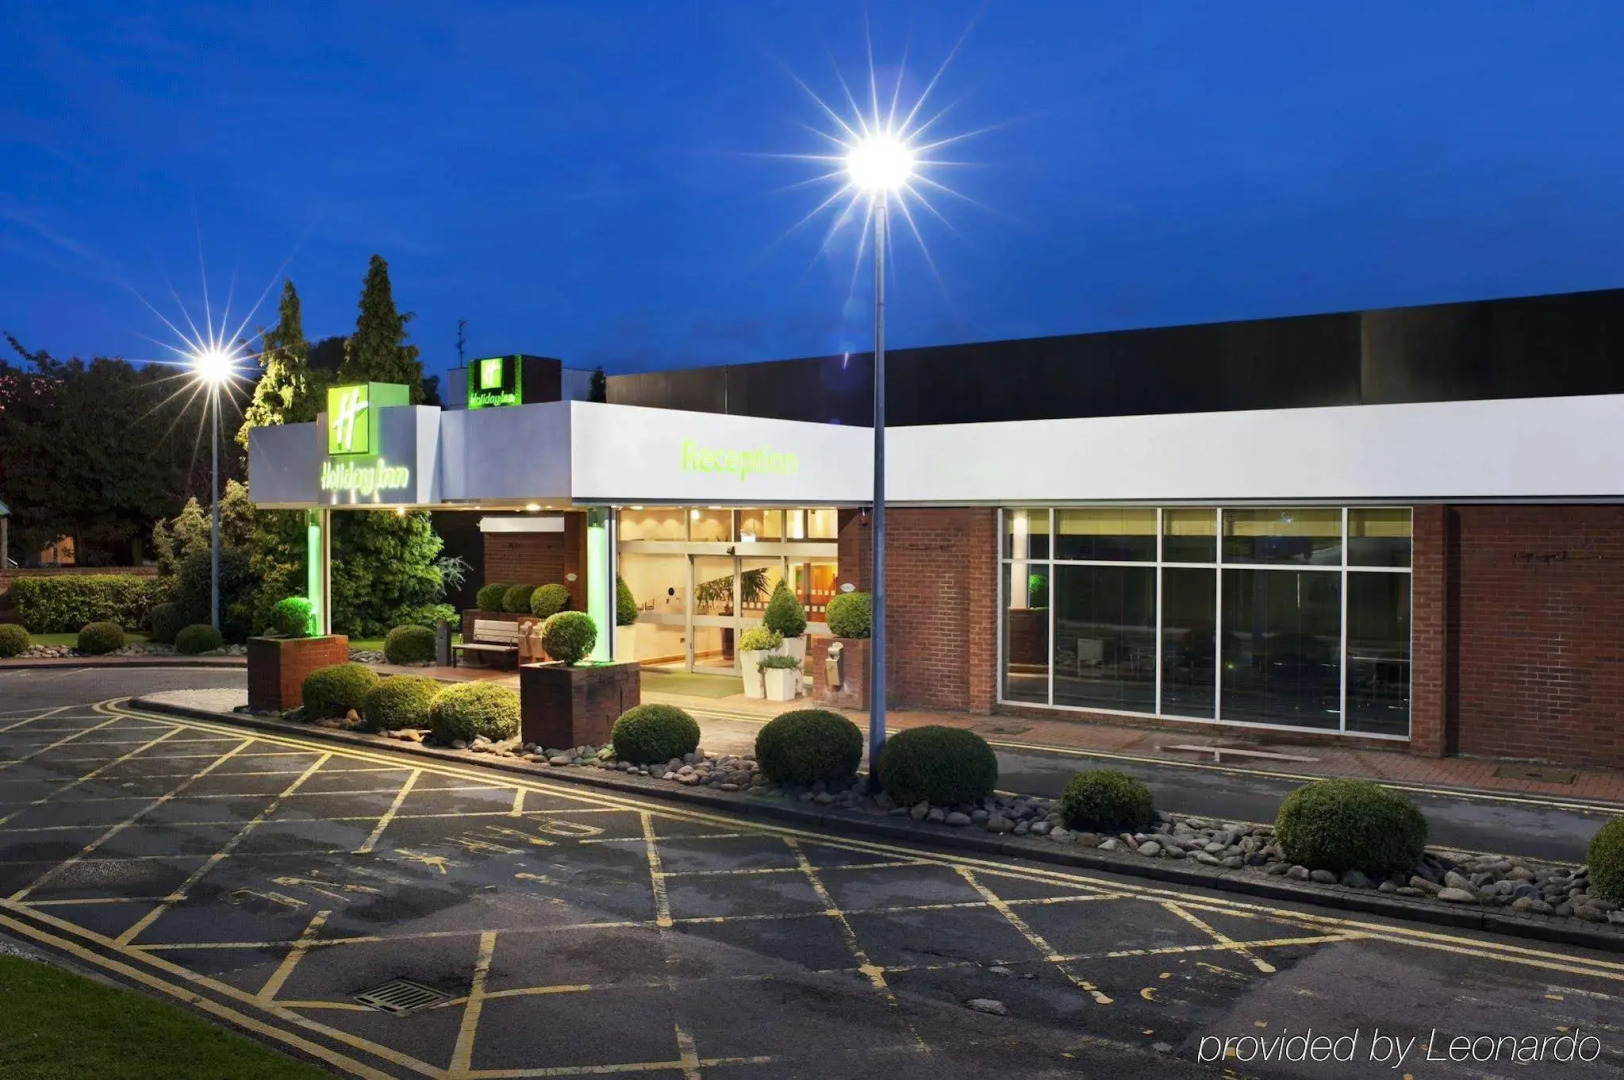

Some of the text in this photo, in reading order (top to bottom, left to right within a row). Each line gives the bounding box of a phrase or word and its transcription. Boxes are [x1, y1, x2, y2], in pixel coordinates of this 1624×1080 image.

[470, 392, 501, 407] Holiday
[321, 458, 410, 496] Holiday Inn
[682, 439, 798, 482] Reception
